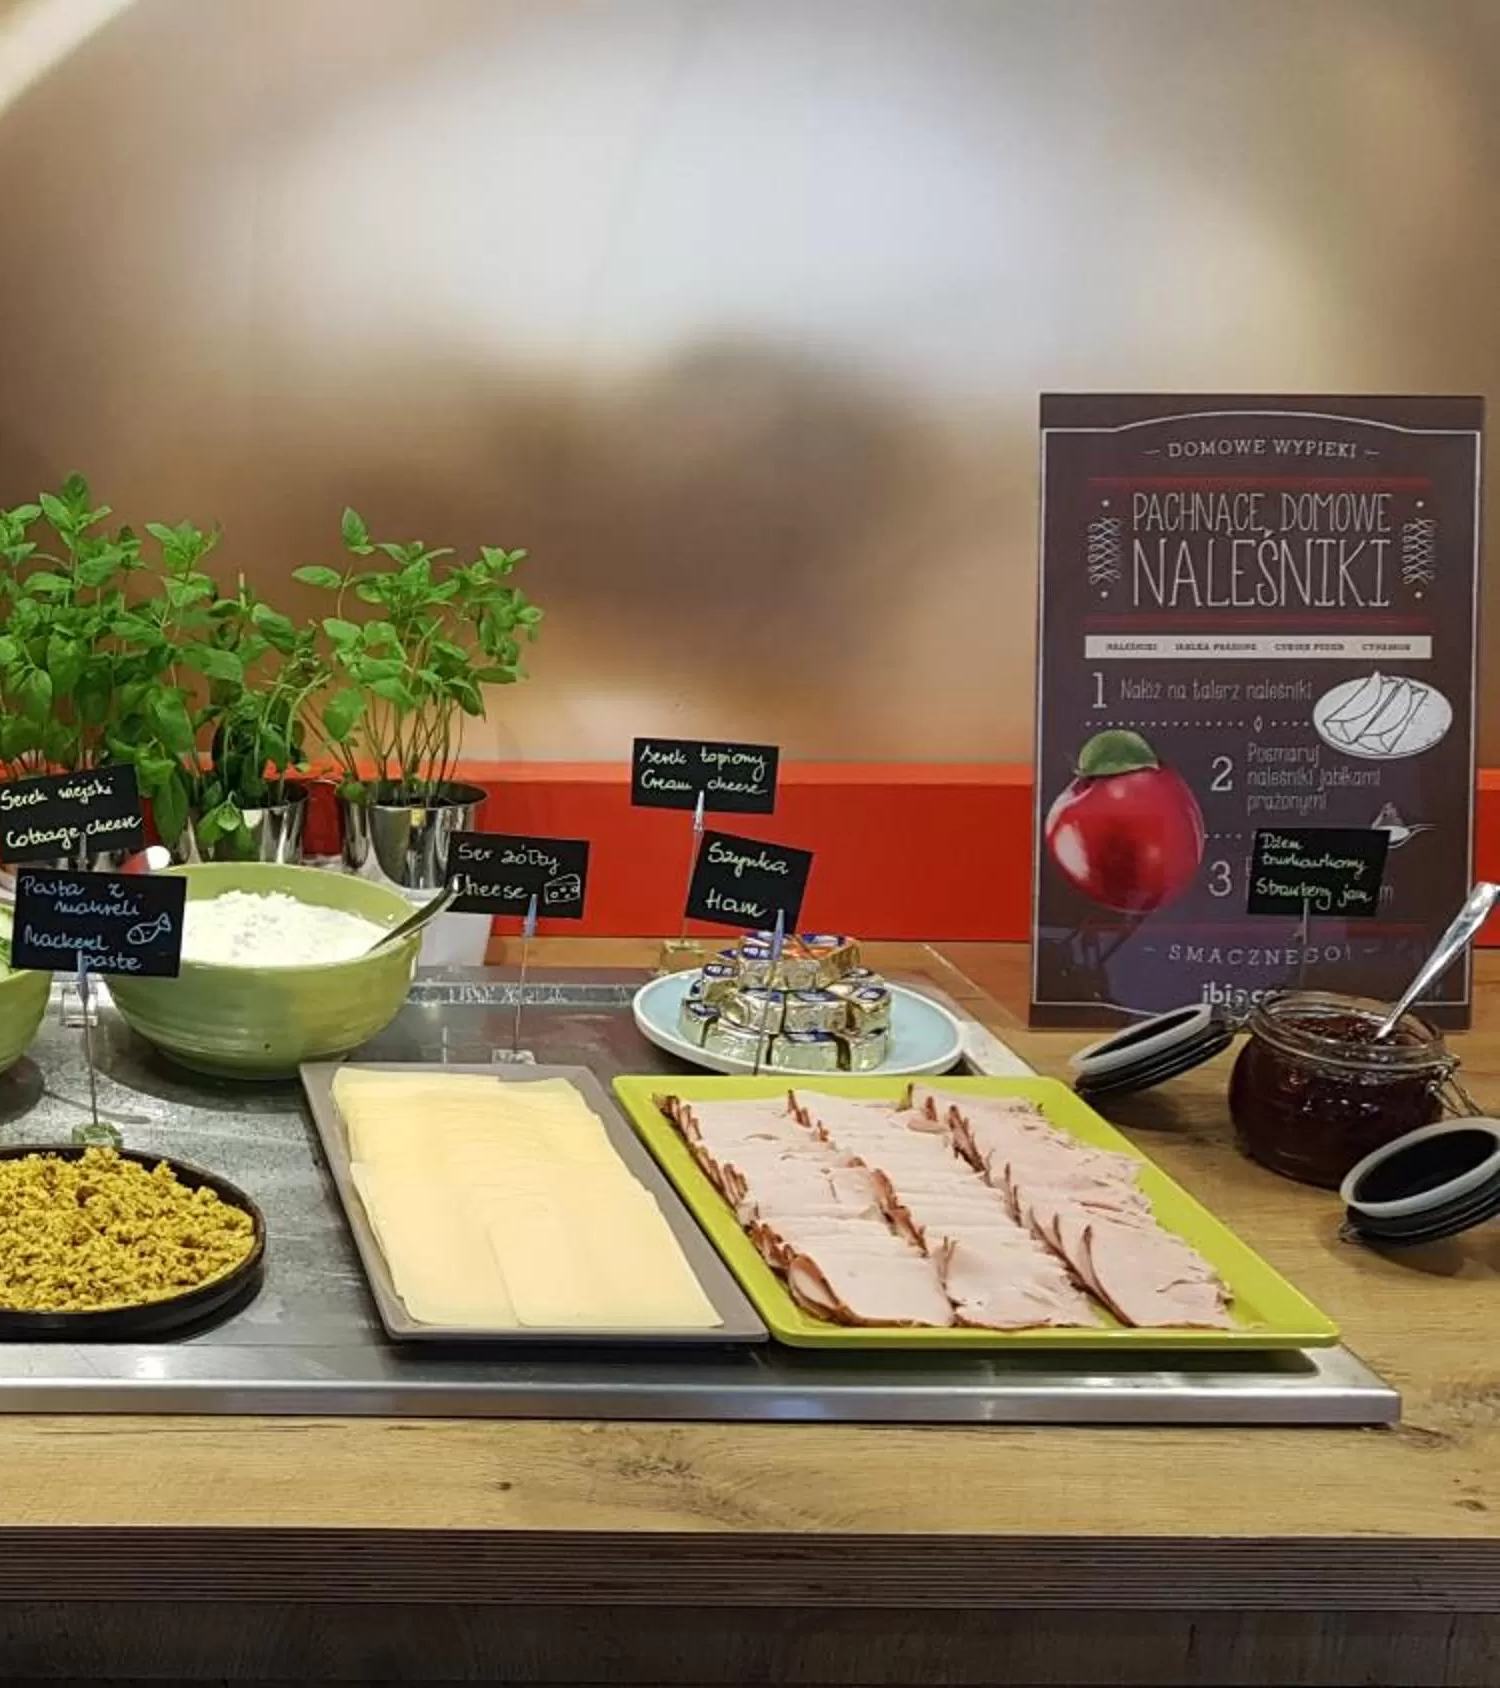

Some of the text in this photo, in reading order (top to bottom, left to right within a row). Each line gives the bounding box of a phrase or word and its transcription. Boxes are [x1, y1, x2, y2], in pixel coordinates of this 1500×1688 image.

[1167, 439, 1357, 458] DOMOWE WYPIEKI
[1133, 491, 1392, 537] PACHNĄCE DOMOWE
[1133, 529, 1391, 606] NALEŚNIKI
[1092, 671, 1107, 708] 1
[1167, 683, 1187, 699] na
[640, 744, 687, 764] Serek
[641, 769, 768, 794] Cream cheese
[1210, 755, 1233, 791] 2
[0, 789, 48, 811] Serek
[6, 815, 143, 849] Cottage cheese
[458, 842, 493, 861] Ser
[707, 841, 789, 878] Szynka
[19, 875, 125, 898] Pasta z
[453, 873, 528, 899] Cheese
[1208, 860, 1232, 896] 3
[54, 893, 140, 916] makreli
[704, 887, 767, 917] Ham
[78, 951, 142, 970] paste
